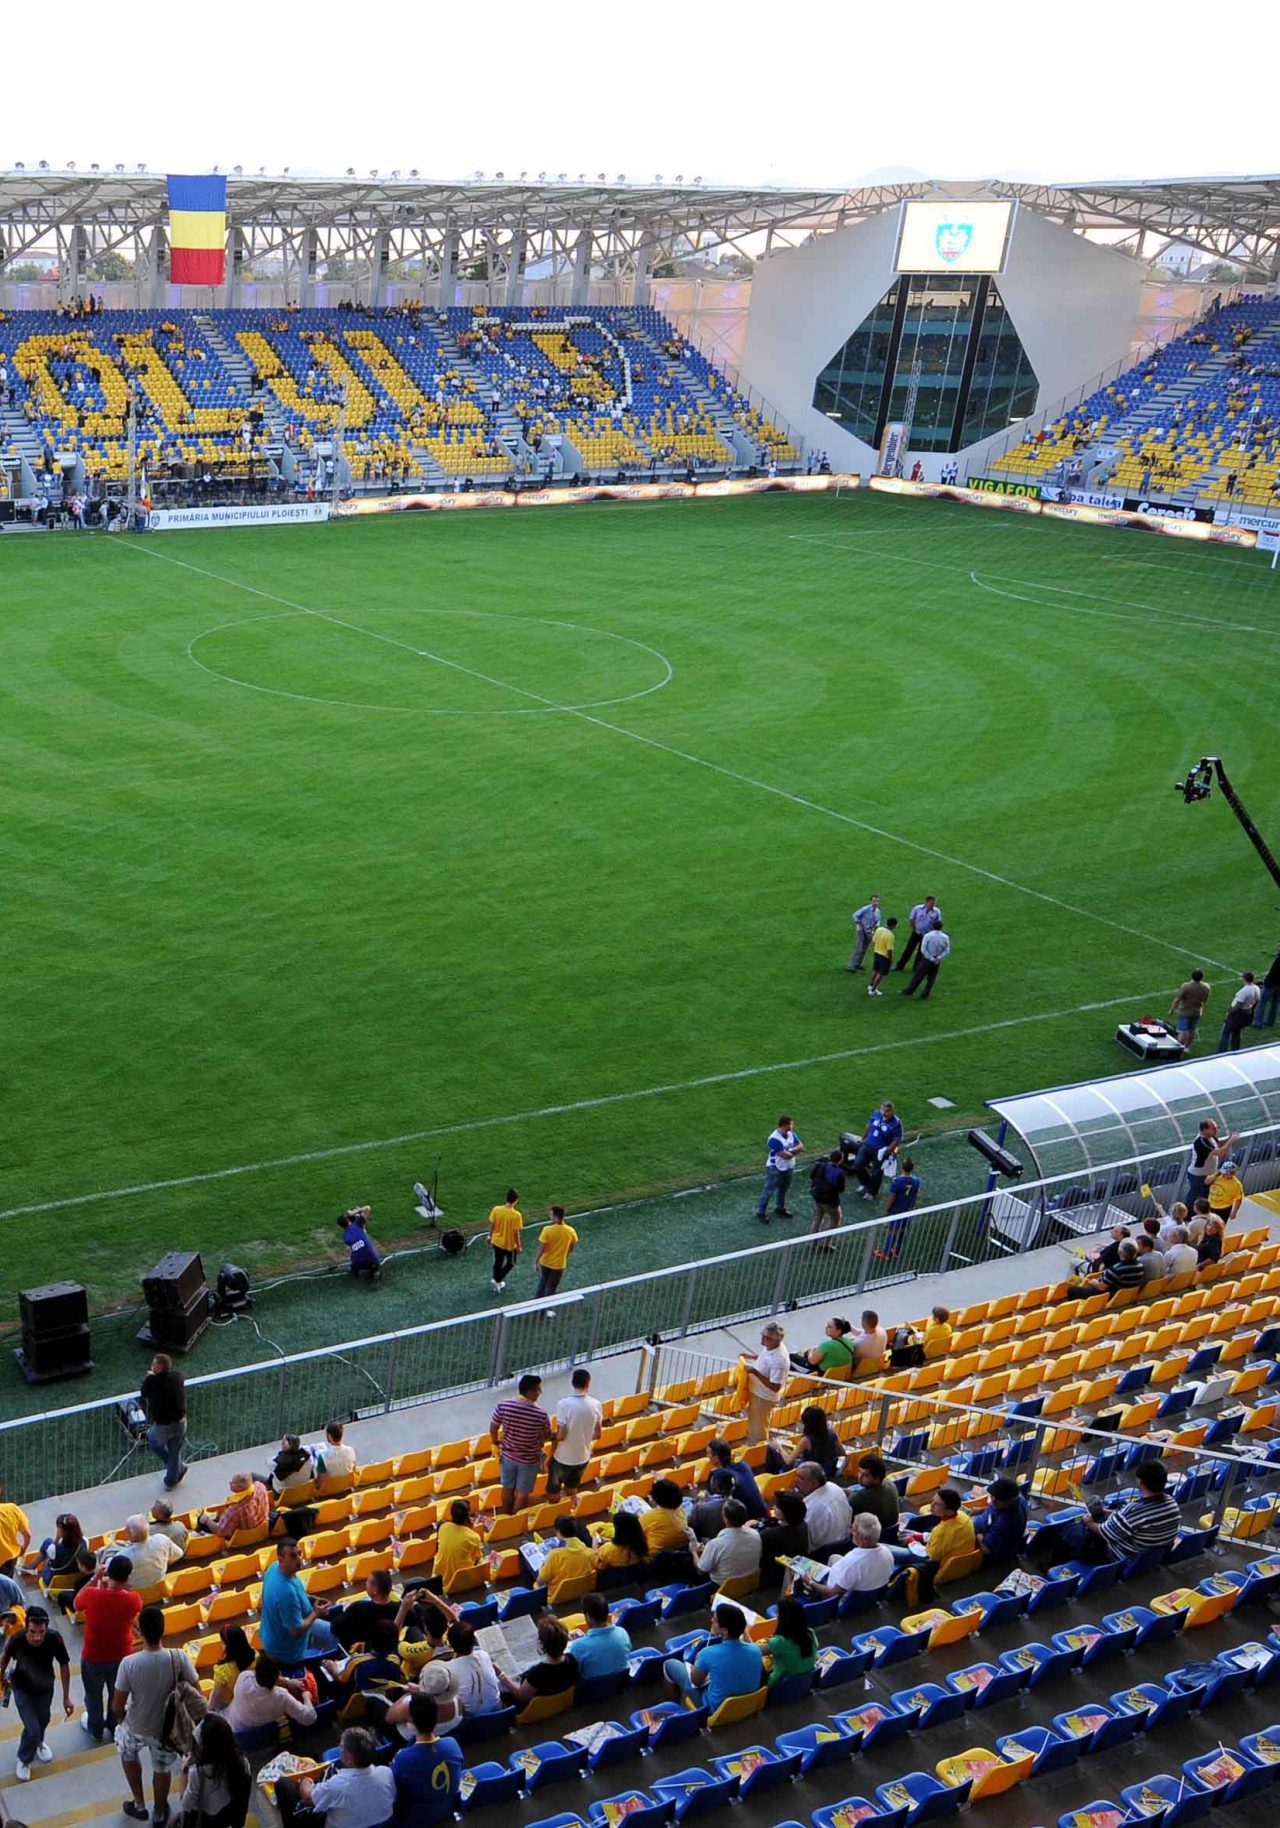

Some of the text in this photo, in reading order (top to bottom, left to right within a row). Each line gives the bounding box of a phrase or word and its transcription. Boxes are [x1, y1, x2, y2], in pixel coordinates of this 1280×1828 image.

[969, 478, 1039, 498] VIGAFON
[211, 510, 270, 522] MUNICIPIULUI
[1048, 505, 1078, 516] mercury
[1137, 502, 1196, 521] Ceresit
[905, 1184, 913, 1196] 7
[431, 1760, 451, 1795] 9
